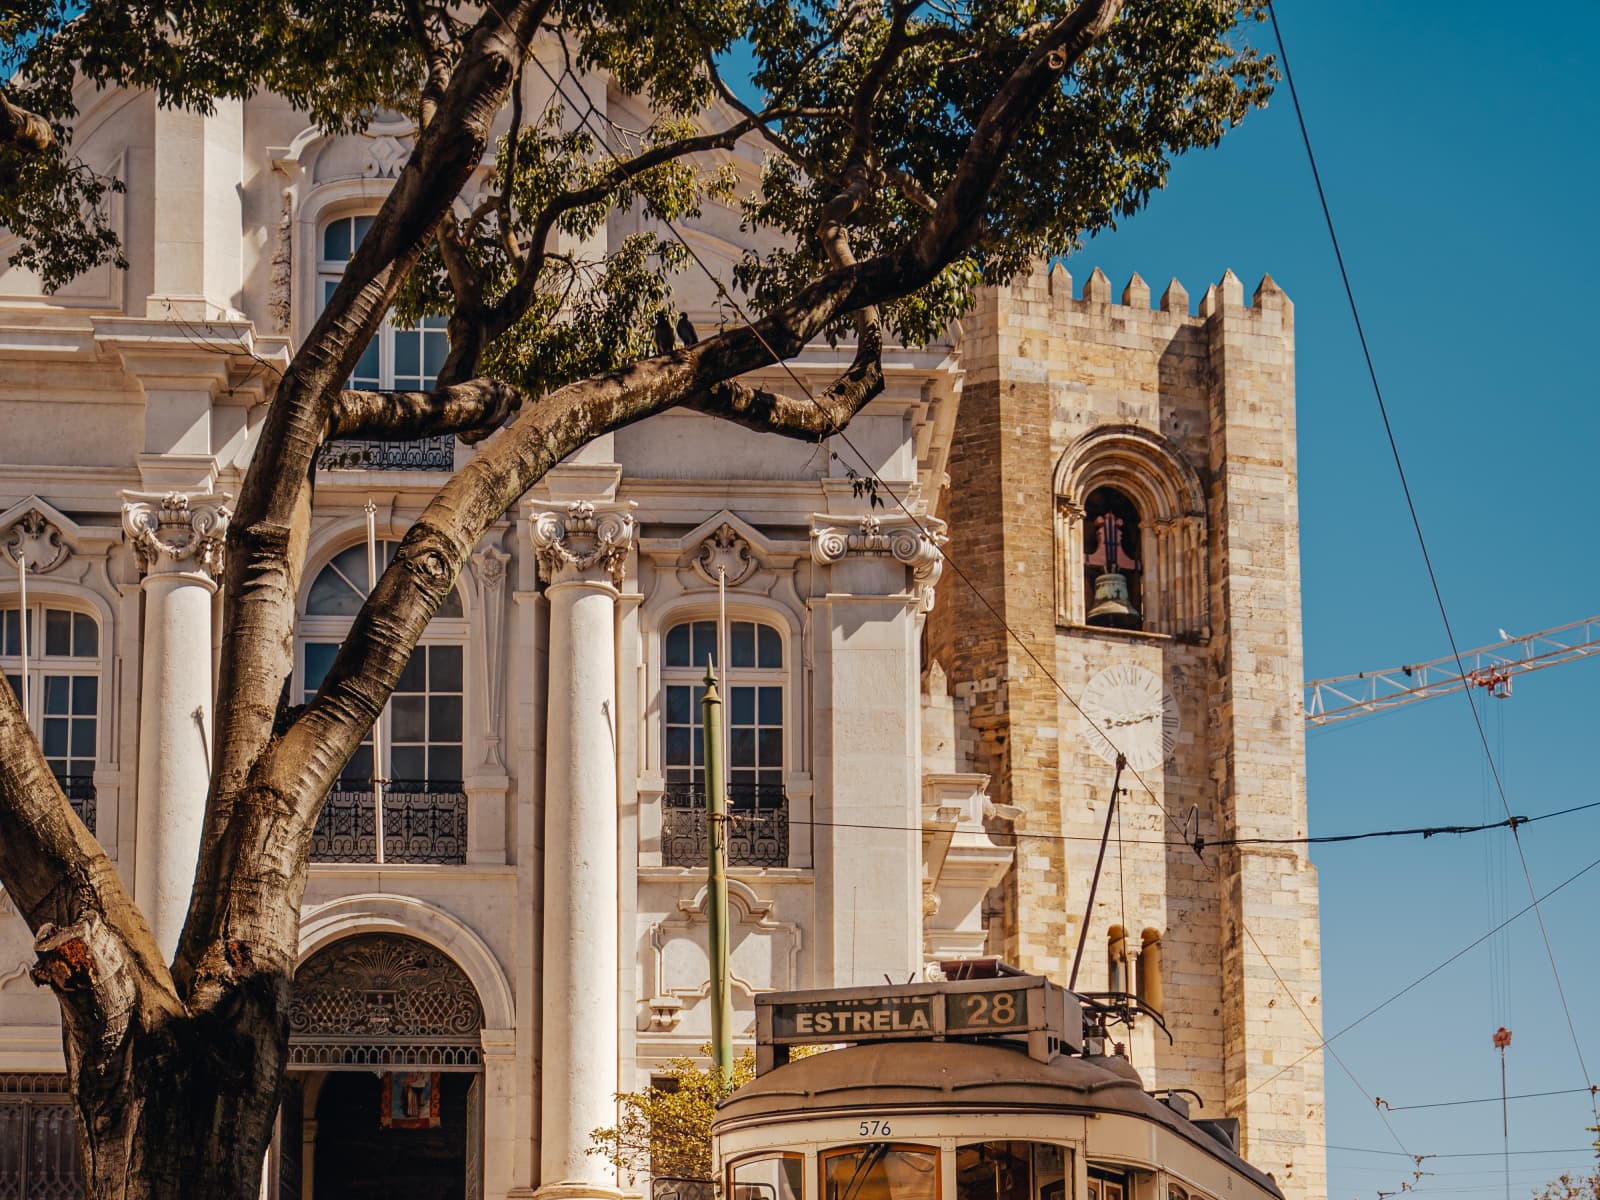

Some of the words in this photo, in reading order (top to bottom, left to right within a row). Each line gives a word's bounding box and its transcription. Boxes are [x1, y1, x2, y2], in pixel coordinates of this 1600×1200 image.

[796, 1009, 929, 1033] ESTRELA
[967, 993, 1016, 1025] 28
[859, 1120, 891, 1136] 576
